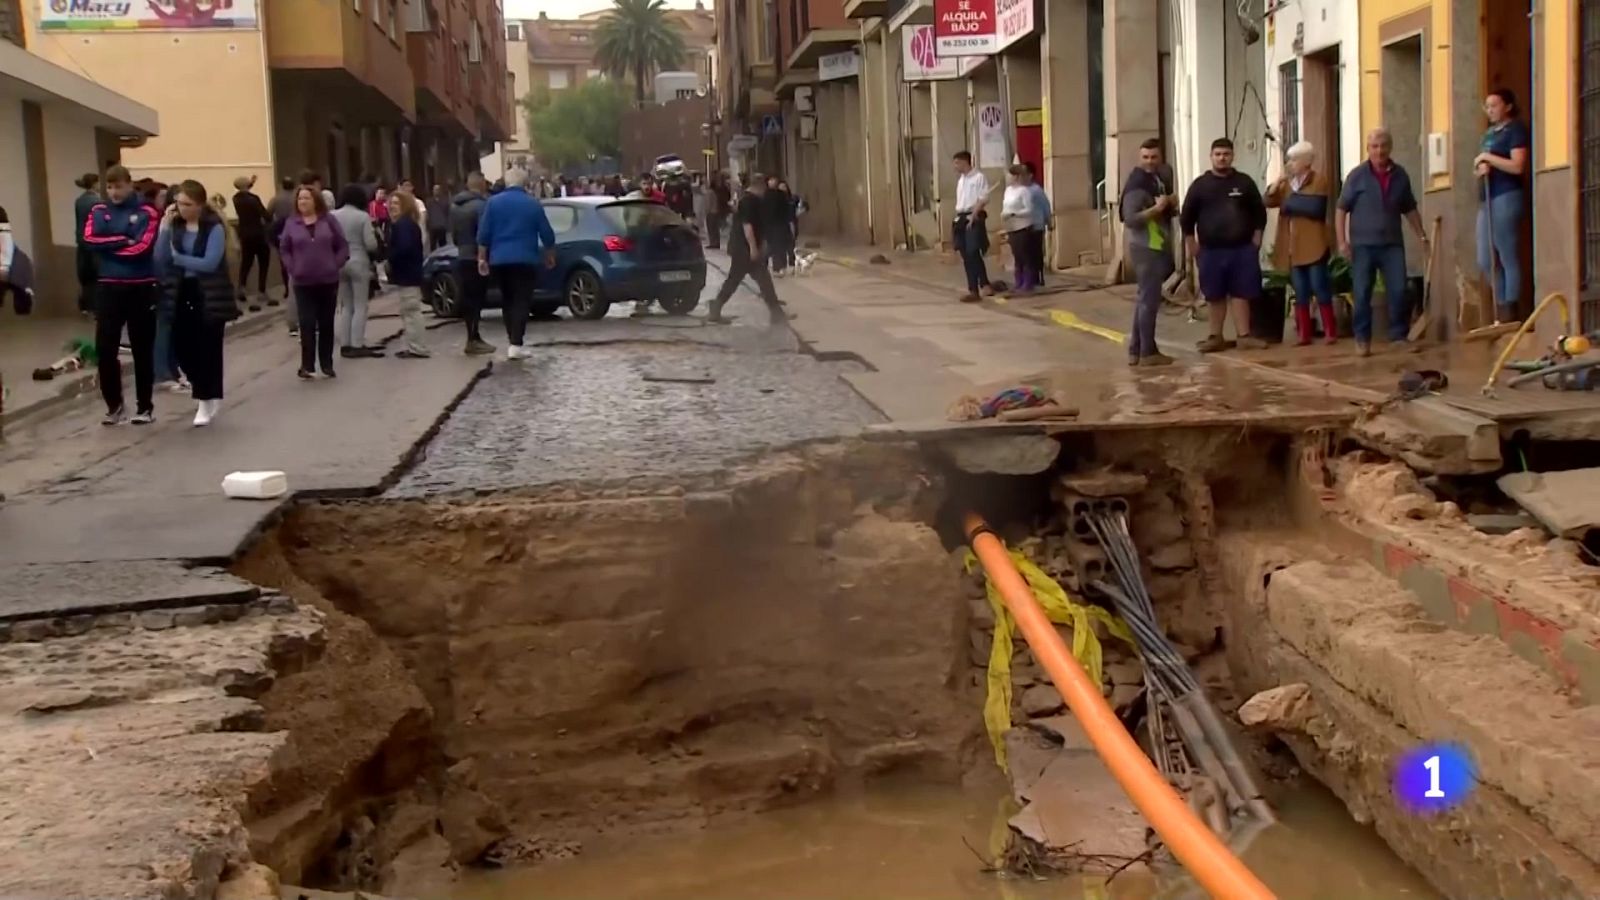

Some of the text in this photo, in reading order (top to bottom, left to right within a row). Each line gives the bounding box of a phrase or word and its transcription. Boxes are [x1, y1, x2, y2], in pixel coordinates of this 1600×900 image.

[70, 0, 131, 16] Macy
[958, 1, 971, 10] SE
[942, 11, 988, 23] ALQUILA
[951, 22, 979, 32] BAJO
